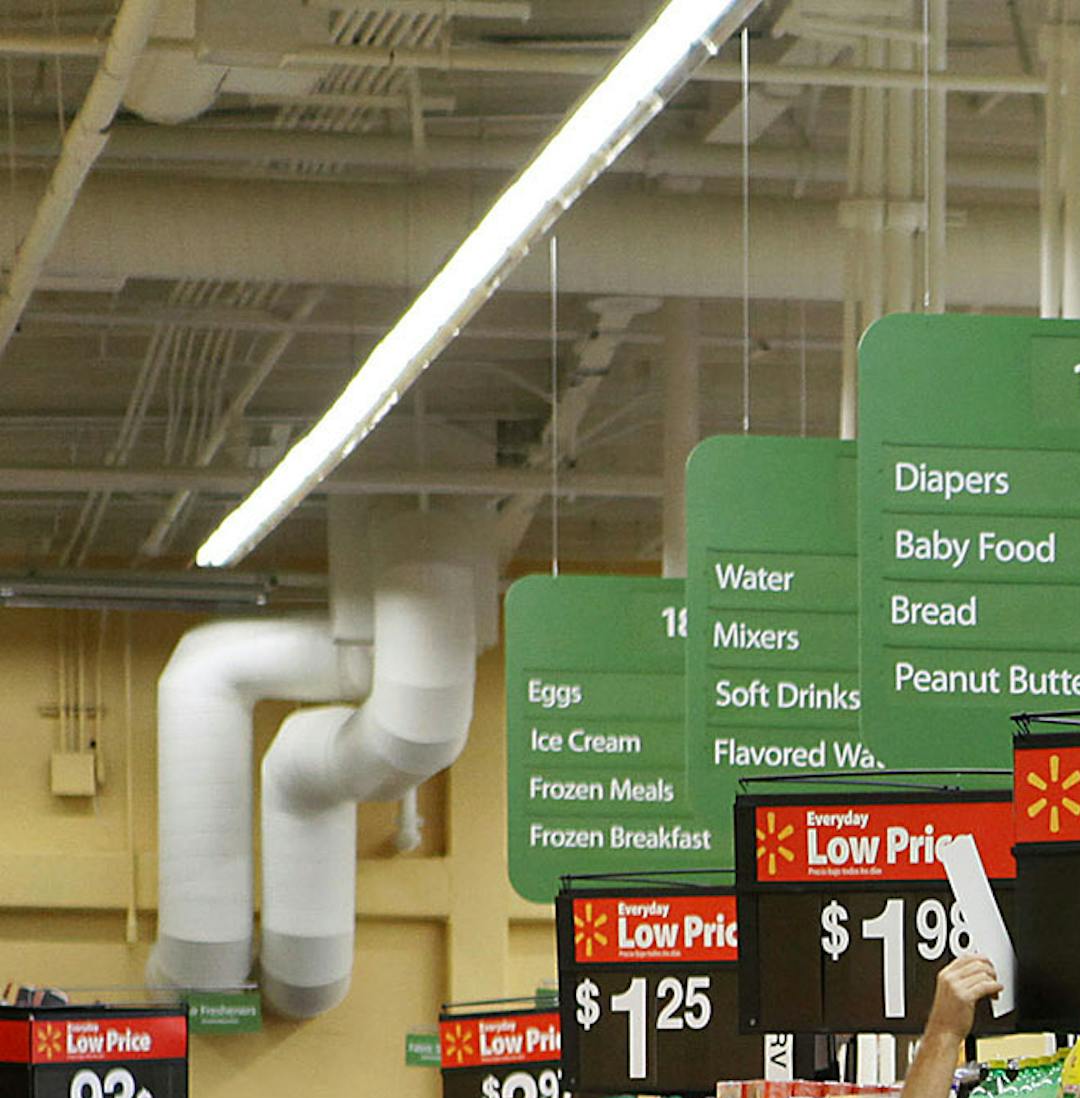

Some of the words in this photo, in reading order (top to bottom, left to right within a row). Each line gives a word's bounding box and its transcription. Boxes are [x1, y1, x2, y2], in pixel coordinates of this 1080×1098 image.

[895, 462, 1009, 500] Diapers
[895, 529, 970, 567] Baby
[979, 531, 1055, 563] Food
[715, 563, 794, 592] Water
[891, 594, 977, 626] Bread
[713, 621, 799, 651] Mixers
[528, 679, 582, 706] Eggs
[895, 662, 1000, 694] Peanut
[715, 679, 770, 708] Soft
[778, 683, 861, 710] Drinks
[531, 728, 563, 752] Ice
[568, 729, 641, 753] Cream
[714, 738, 826, 768] Flavored
[529, 776, 604, 801] Frozen
[608, 779, 674, 802] Meals
[806, 810, 870, 828] Everyday
[529, 824, 604, 849] Frozen
[609, 826, 712, 850] Breakfast
[806, 827, 878, 865] Low
[618, 901, 670, 919] Everyday
[618, 917, 679, 949] Low
[66, 1032, 105, 1054] Low
[106, 1027, 152, 1053] Price
[480, 1034, 523, 1056] Low
